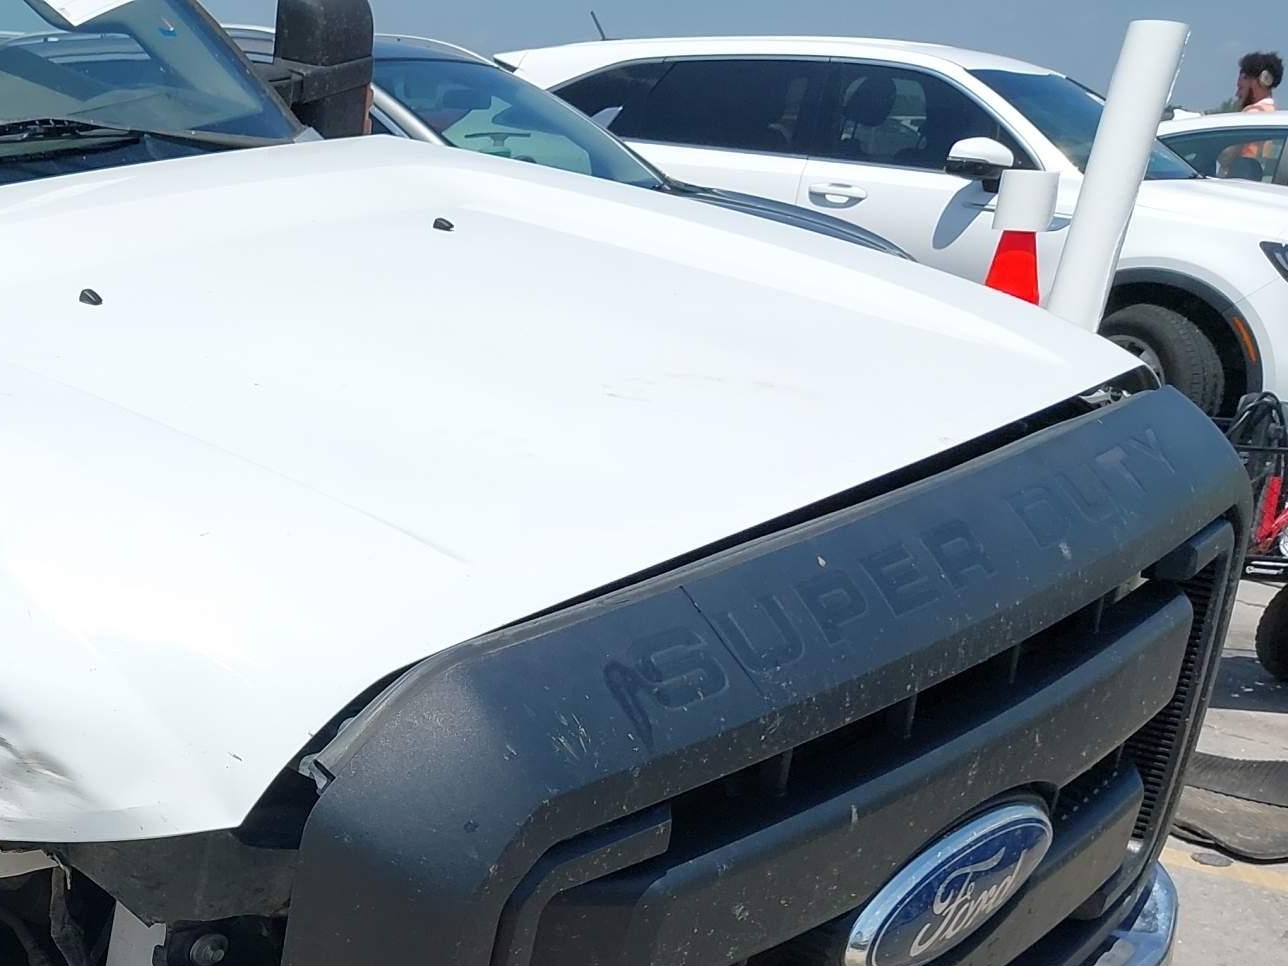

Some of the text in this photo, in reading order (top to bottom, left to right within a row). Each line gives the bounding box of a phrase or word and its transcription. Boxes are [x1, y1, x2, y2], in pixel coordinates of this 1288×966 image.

[631, 428, 1178, 712] SUPER DUTY
[909, 846, 1028, 957] Ford
